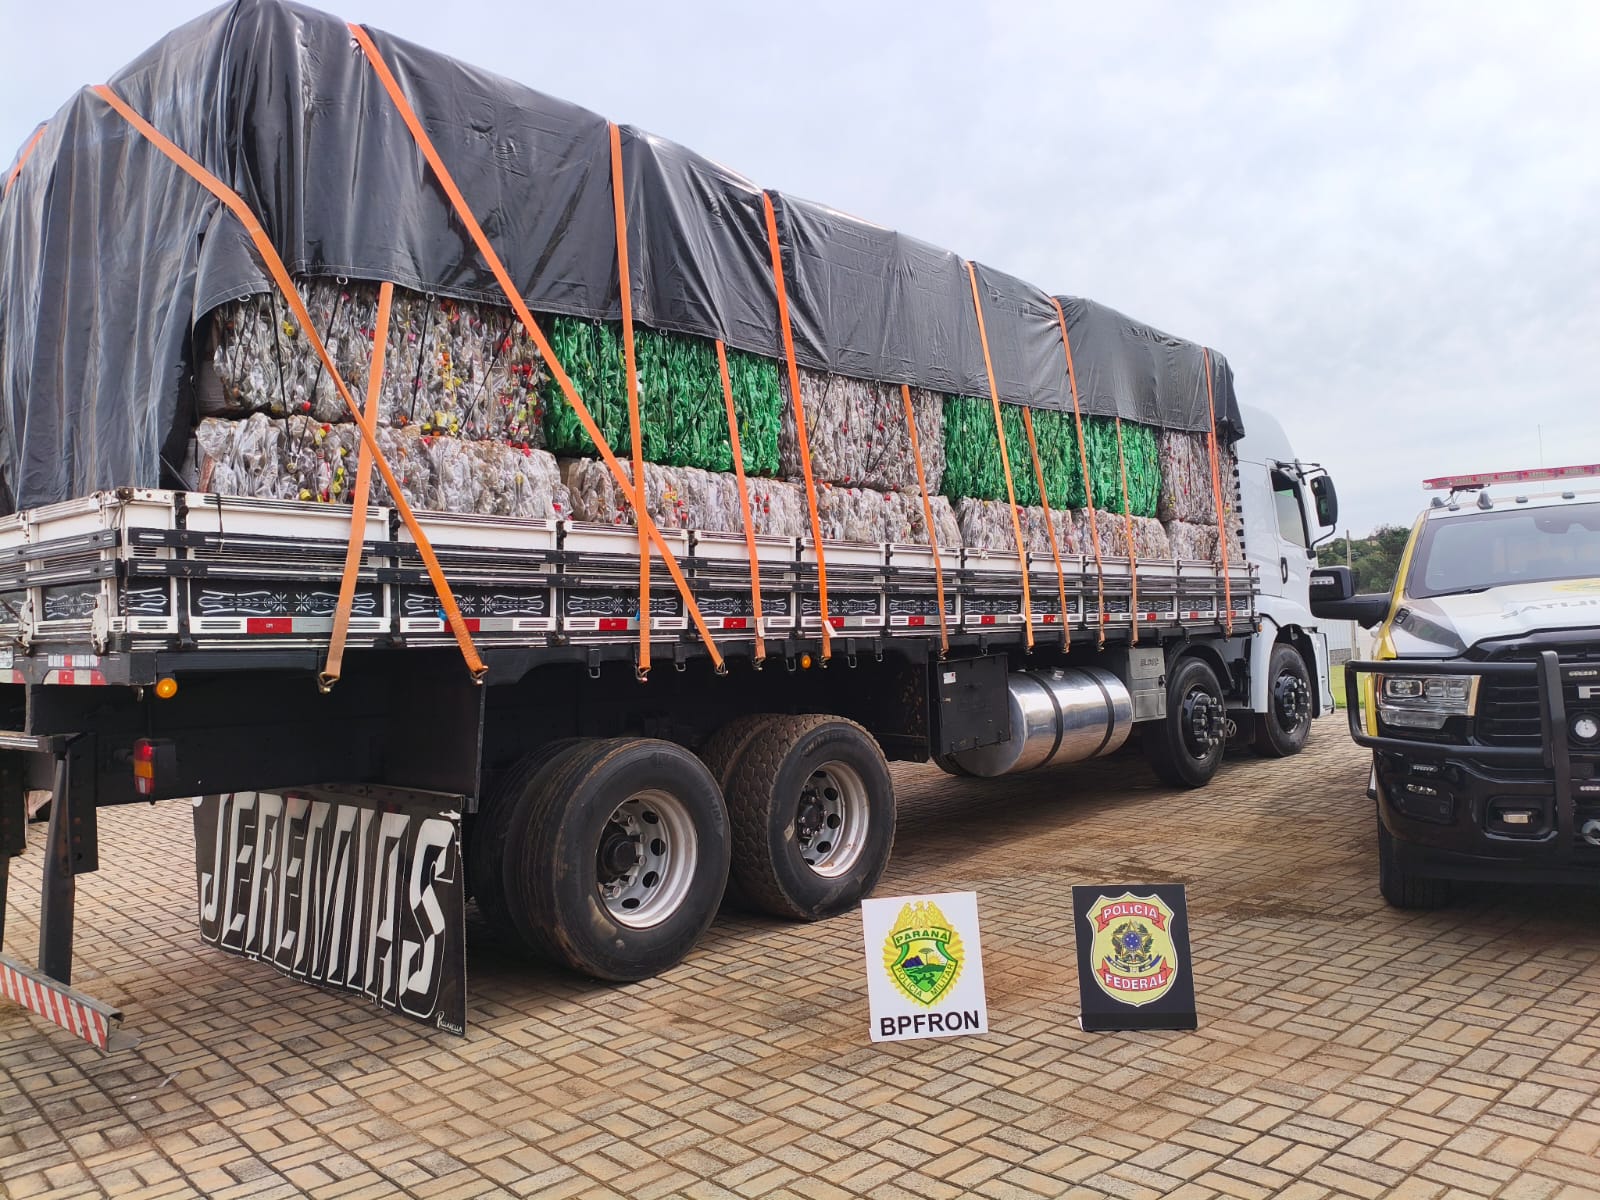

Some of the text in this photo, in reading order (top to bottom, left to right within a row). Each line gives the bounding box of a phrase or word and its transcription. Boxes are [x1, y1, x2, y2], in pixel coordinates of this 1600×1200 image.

[200, 791, 457, 1018] JEREMIAS
[930, 963, 954, 995] MILITAR
[1105, 973, 1166, 990] FEDERAL
[880, 1010, 980, 1036] BPFRON
